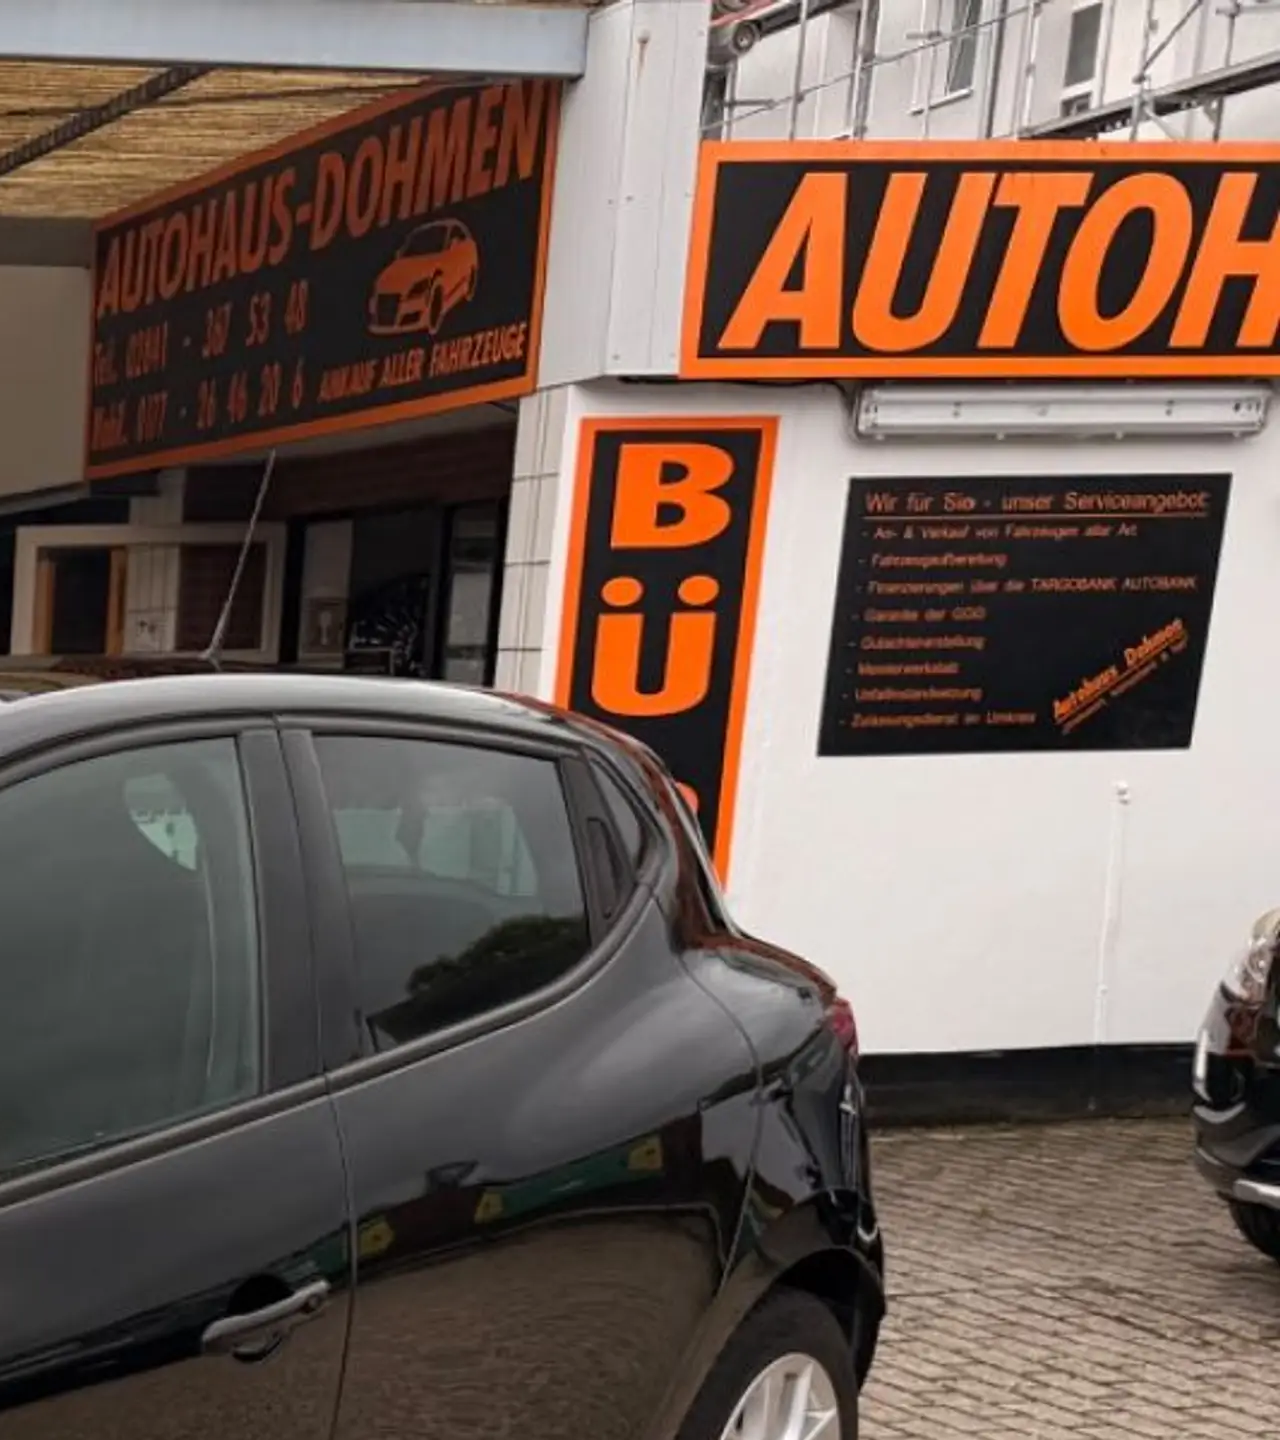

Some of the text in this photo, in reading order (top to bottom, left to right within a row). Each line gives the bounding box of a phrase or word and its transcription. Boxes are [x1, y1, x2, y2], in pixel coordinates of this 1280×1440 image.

[96, 82, 540, 318] AUTOHAUS-DOHMEN
[718, 172, 1280, 352] AUTOH
[381, 348, 425, 387] ALLER
[430, 322, 527, 378] FAHRZEUGE
[865, 491, 898, 512] Wir
[906, 491, 934, 512] für
[944, 491, 976, 512] Sie
[1002, 494, 1054, 511] unser
[1064, 491, 1210, 514] Serviceangebot
[591, 442, 735, 815] BÜ
